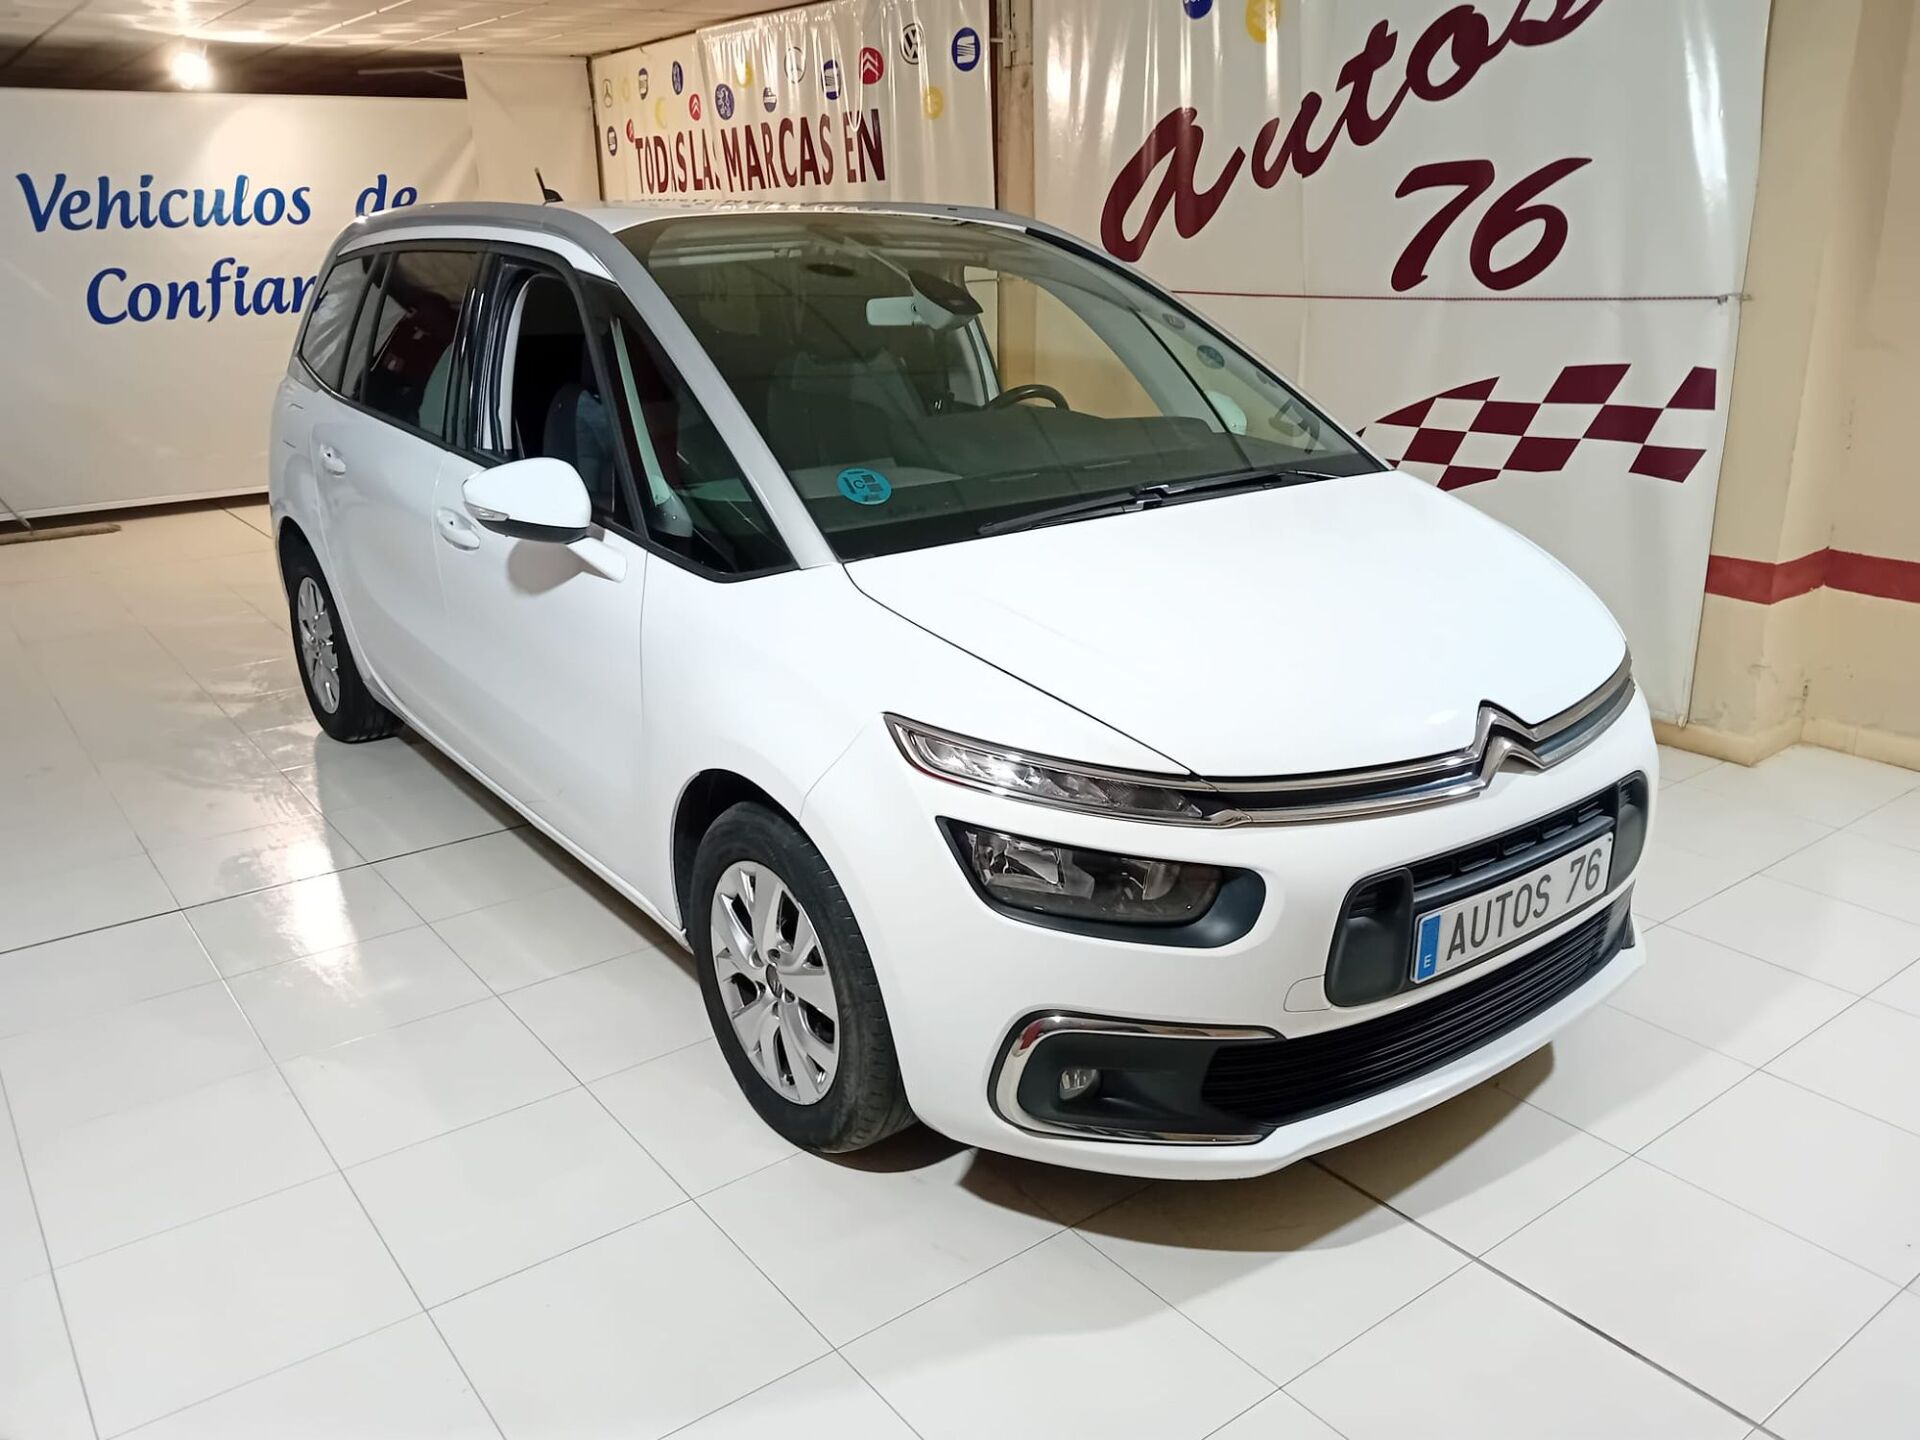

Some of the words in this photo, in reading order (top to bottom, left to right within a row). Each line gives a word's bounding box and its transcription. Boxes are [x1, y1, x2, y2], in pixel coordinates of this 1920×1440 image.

[721, 113, 834, 193] MARCAS
[843, 108, 886, 183] EN
[355, 173, 418, 218] de
[1391, 157, 1593, 292] 76
[1446, 873, 1552, 962] AUTOS
[1565, 847, 1603, 905] 76
[1423, 953, 1432, 969] E
